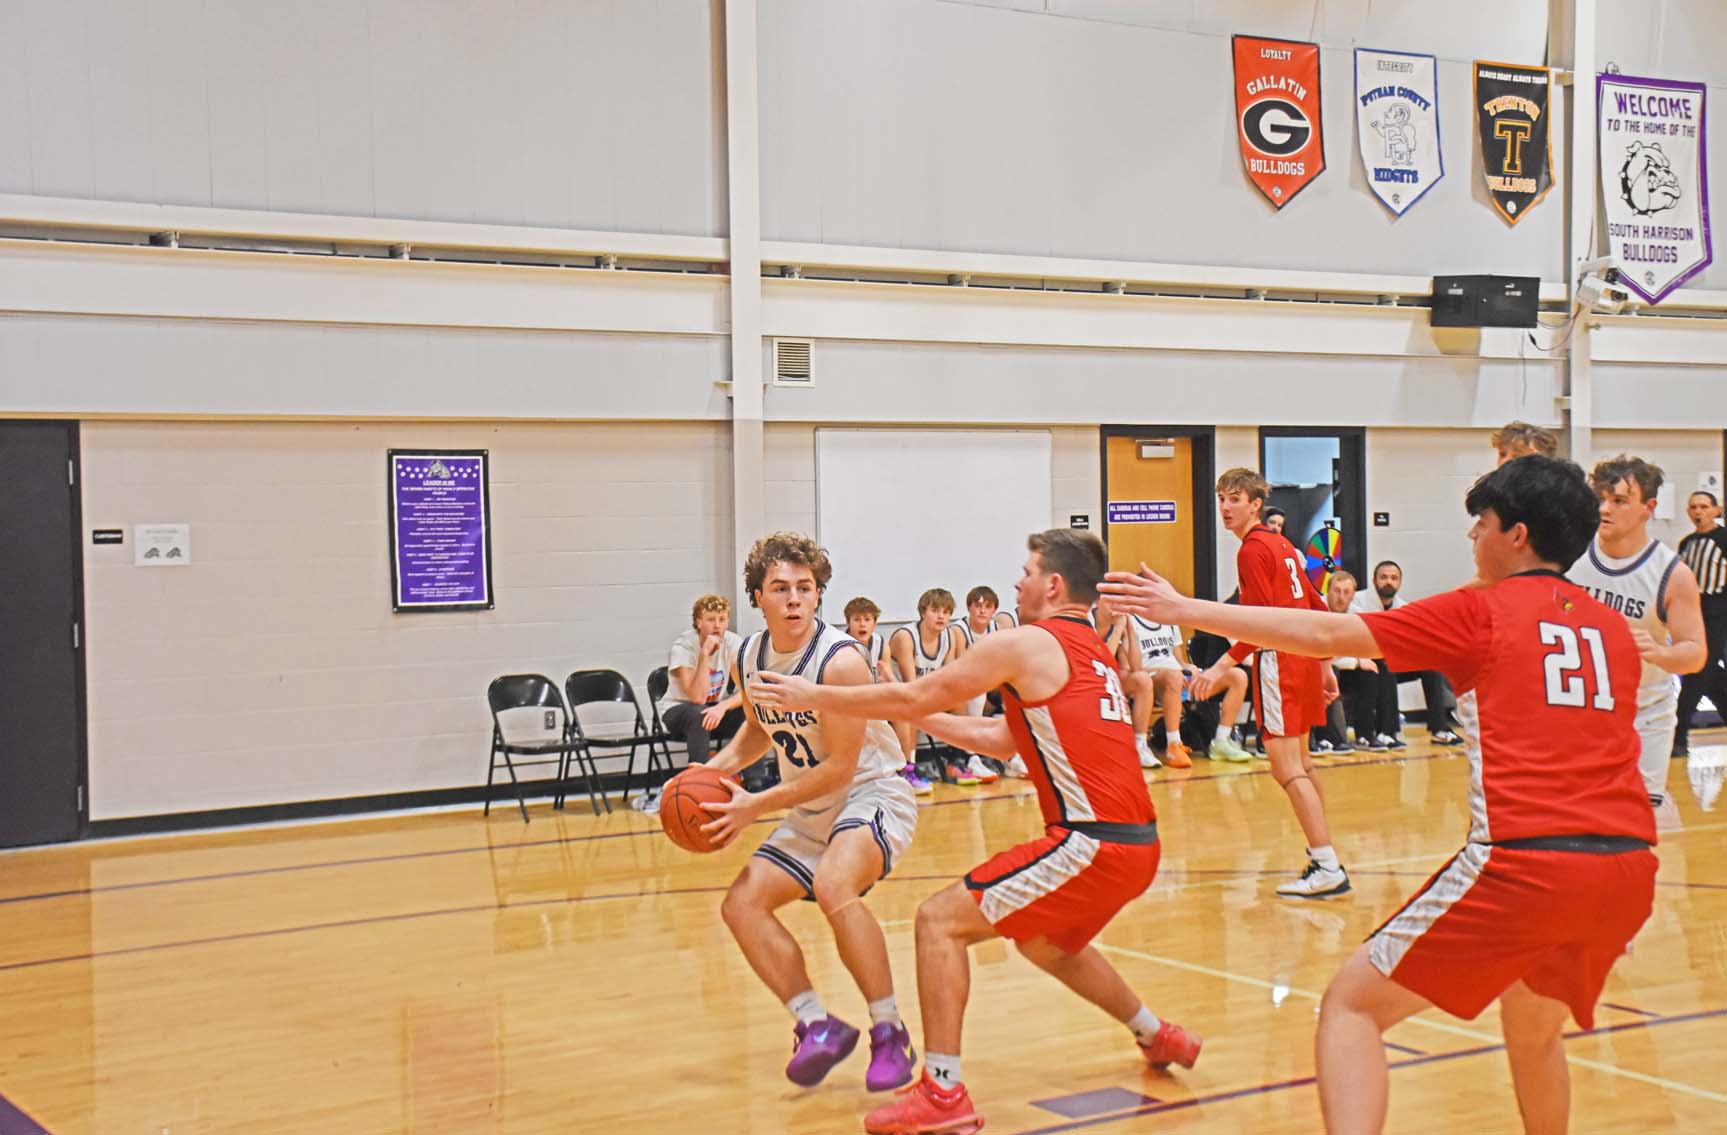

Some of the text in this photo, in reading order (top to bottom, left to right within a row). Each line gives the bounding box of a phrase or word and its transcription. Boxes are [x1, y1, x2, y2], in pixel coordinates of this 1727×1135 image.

[1260, 48, 1292, 61] LOYALTY
[1246, 75, 1307, 101] GALLATIN
[1360, 85, 1432, 112] PUTNAM COUNTY
[1483, 95, 1541, 122] TRENTON
[1614, 92, 1693, 120] WELCOME
[1242, 98, 1312, 157] G
[1607, 118, 1697, 138] TO THE HOME OF THE
[1494, 117, 1532, 175] T
[1250, 158, 1305, 176] BULLDOGS
[1373, 167, 1419, 184] MIDGETS
[1487, 175, 1537, 193] BULLDOGS
[1609, 222, 1694, 242] SOUTH HARRISON
[1622, 243, 1679, 264] BULLDOGS
[1285, 556, 1304, 600] 3
[1538, 619, 1615, 711] 21
[772, 730, 821, 768] 21
